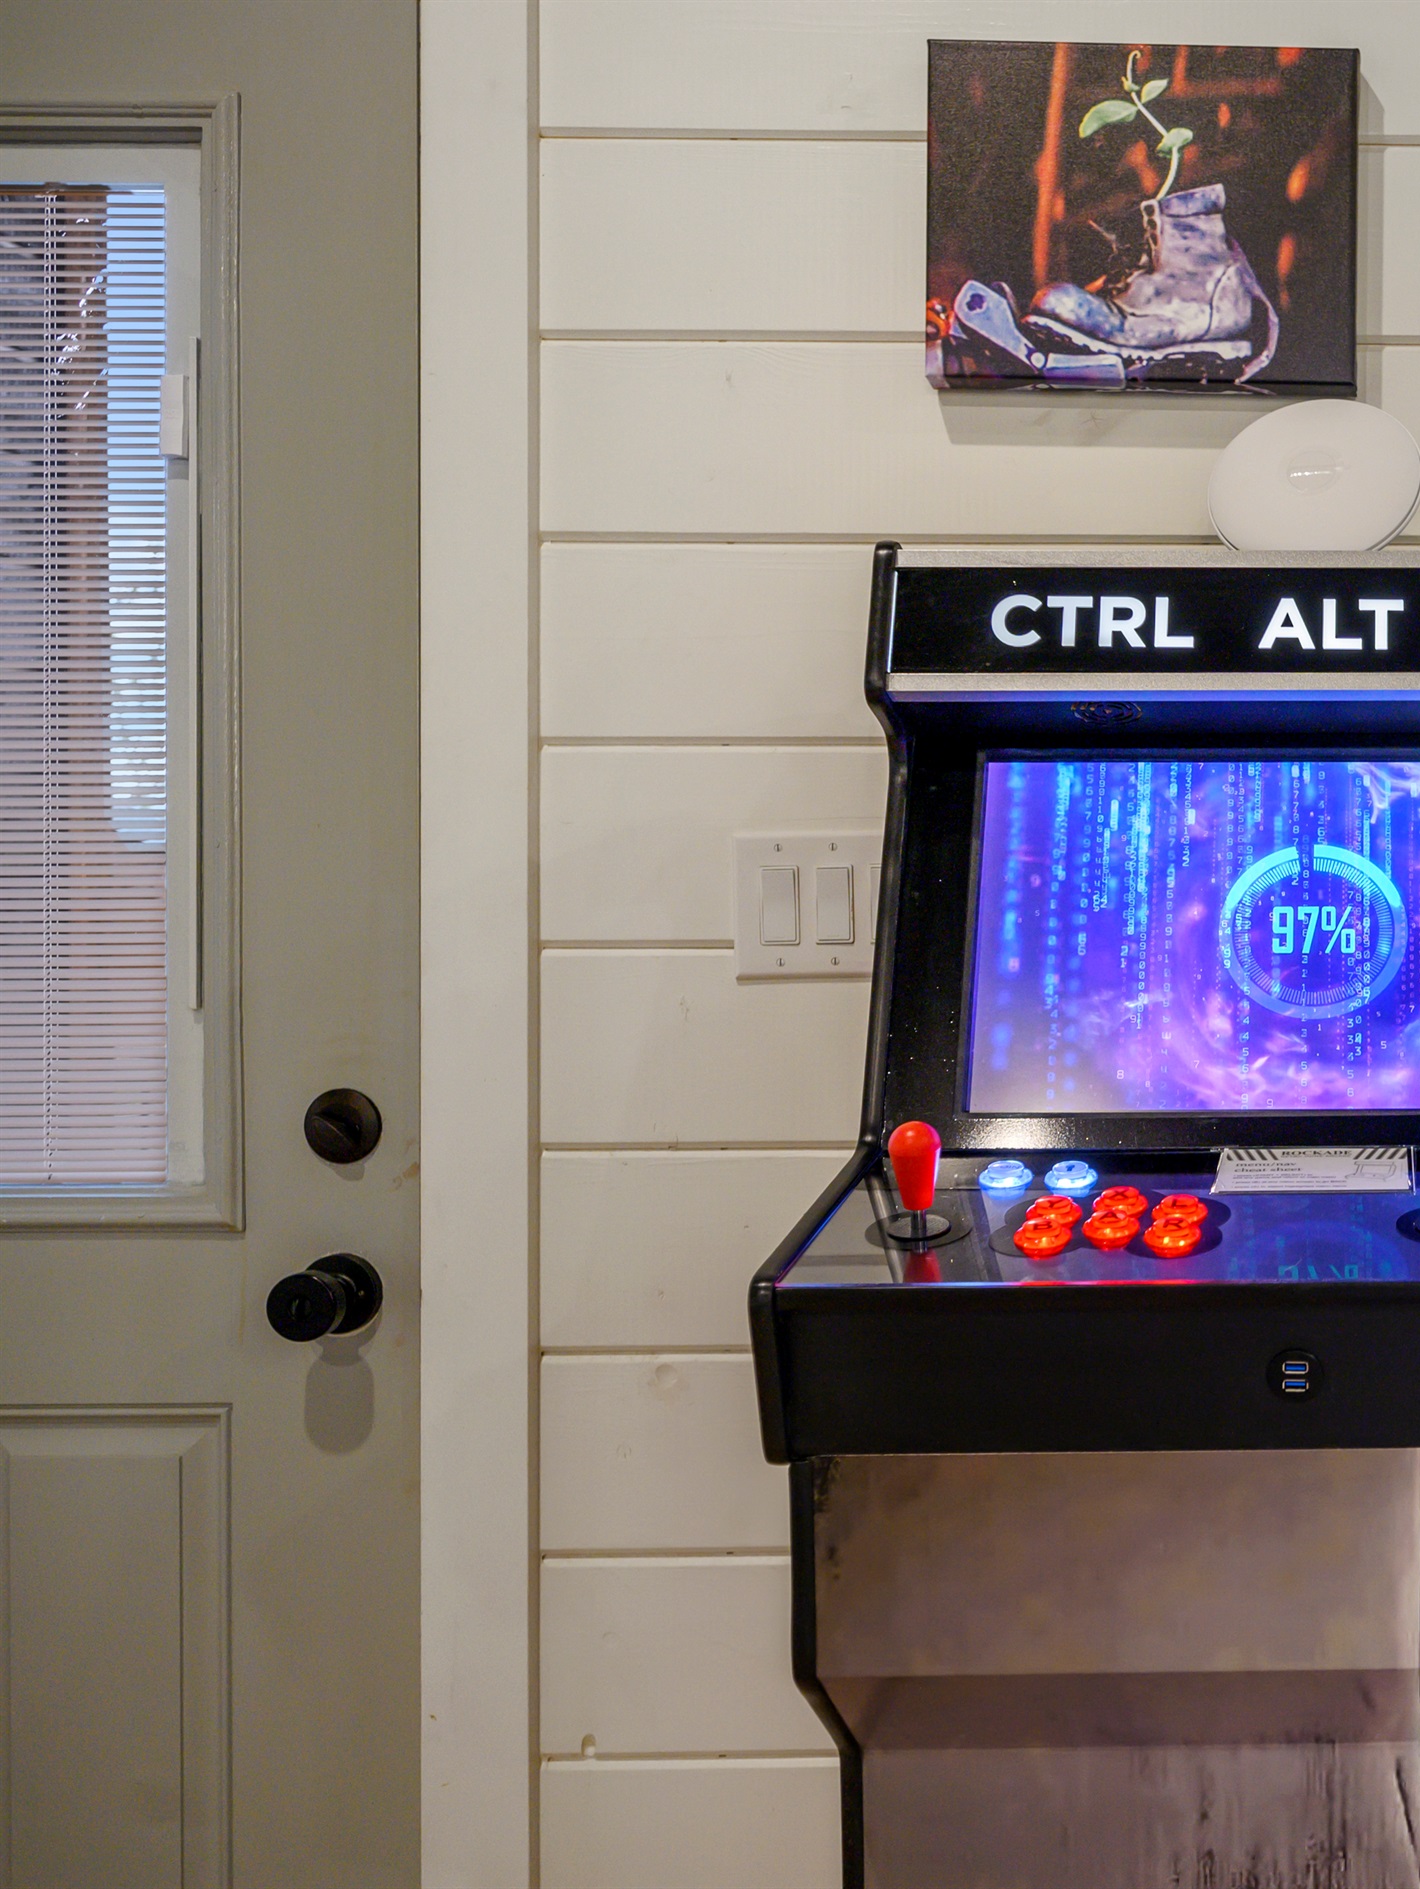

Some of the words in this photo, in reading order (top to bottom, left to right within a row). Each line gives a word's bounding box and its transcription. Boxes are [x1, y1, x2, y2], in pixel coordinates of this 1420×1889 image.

[991, 594, 1195, 649] CTRL
[1258, 597, 1405, 651] ALT
[1272, 905, 1353, 954] 97%
